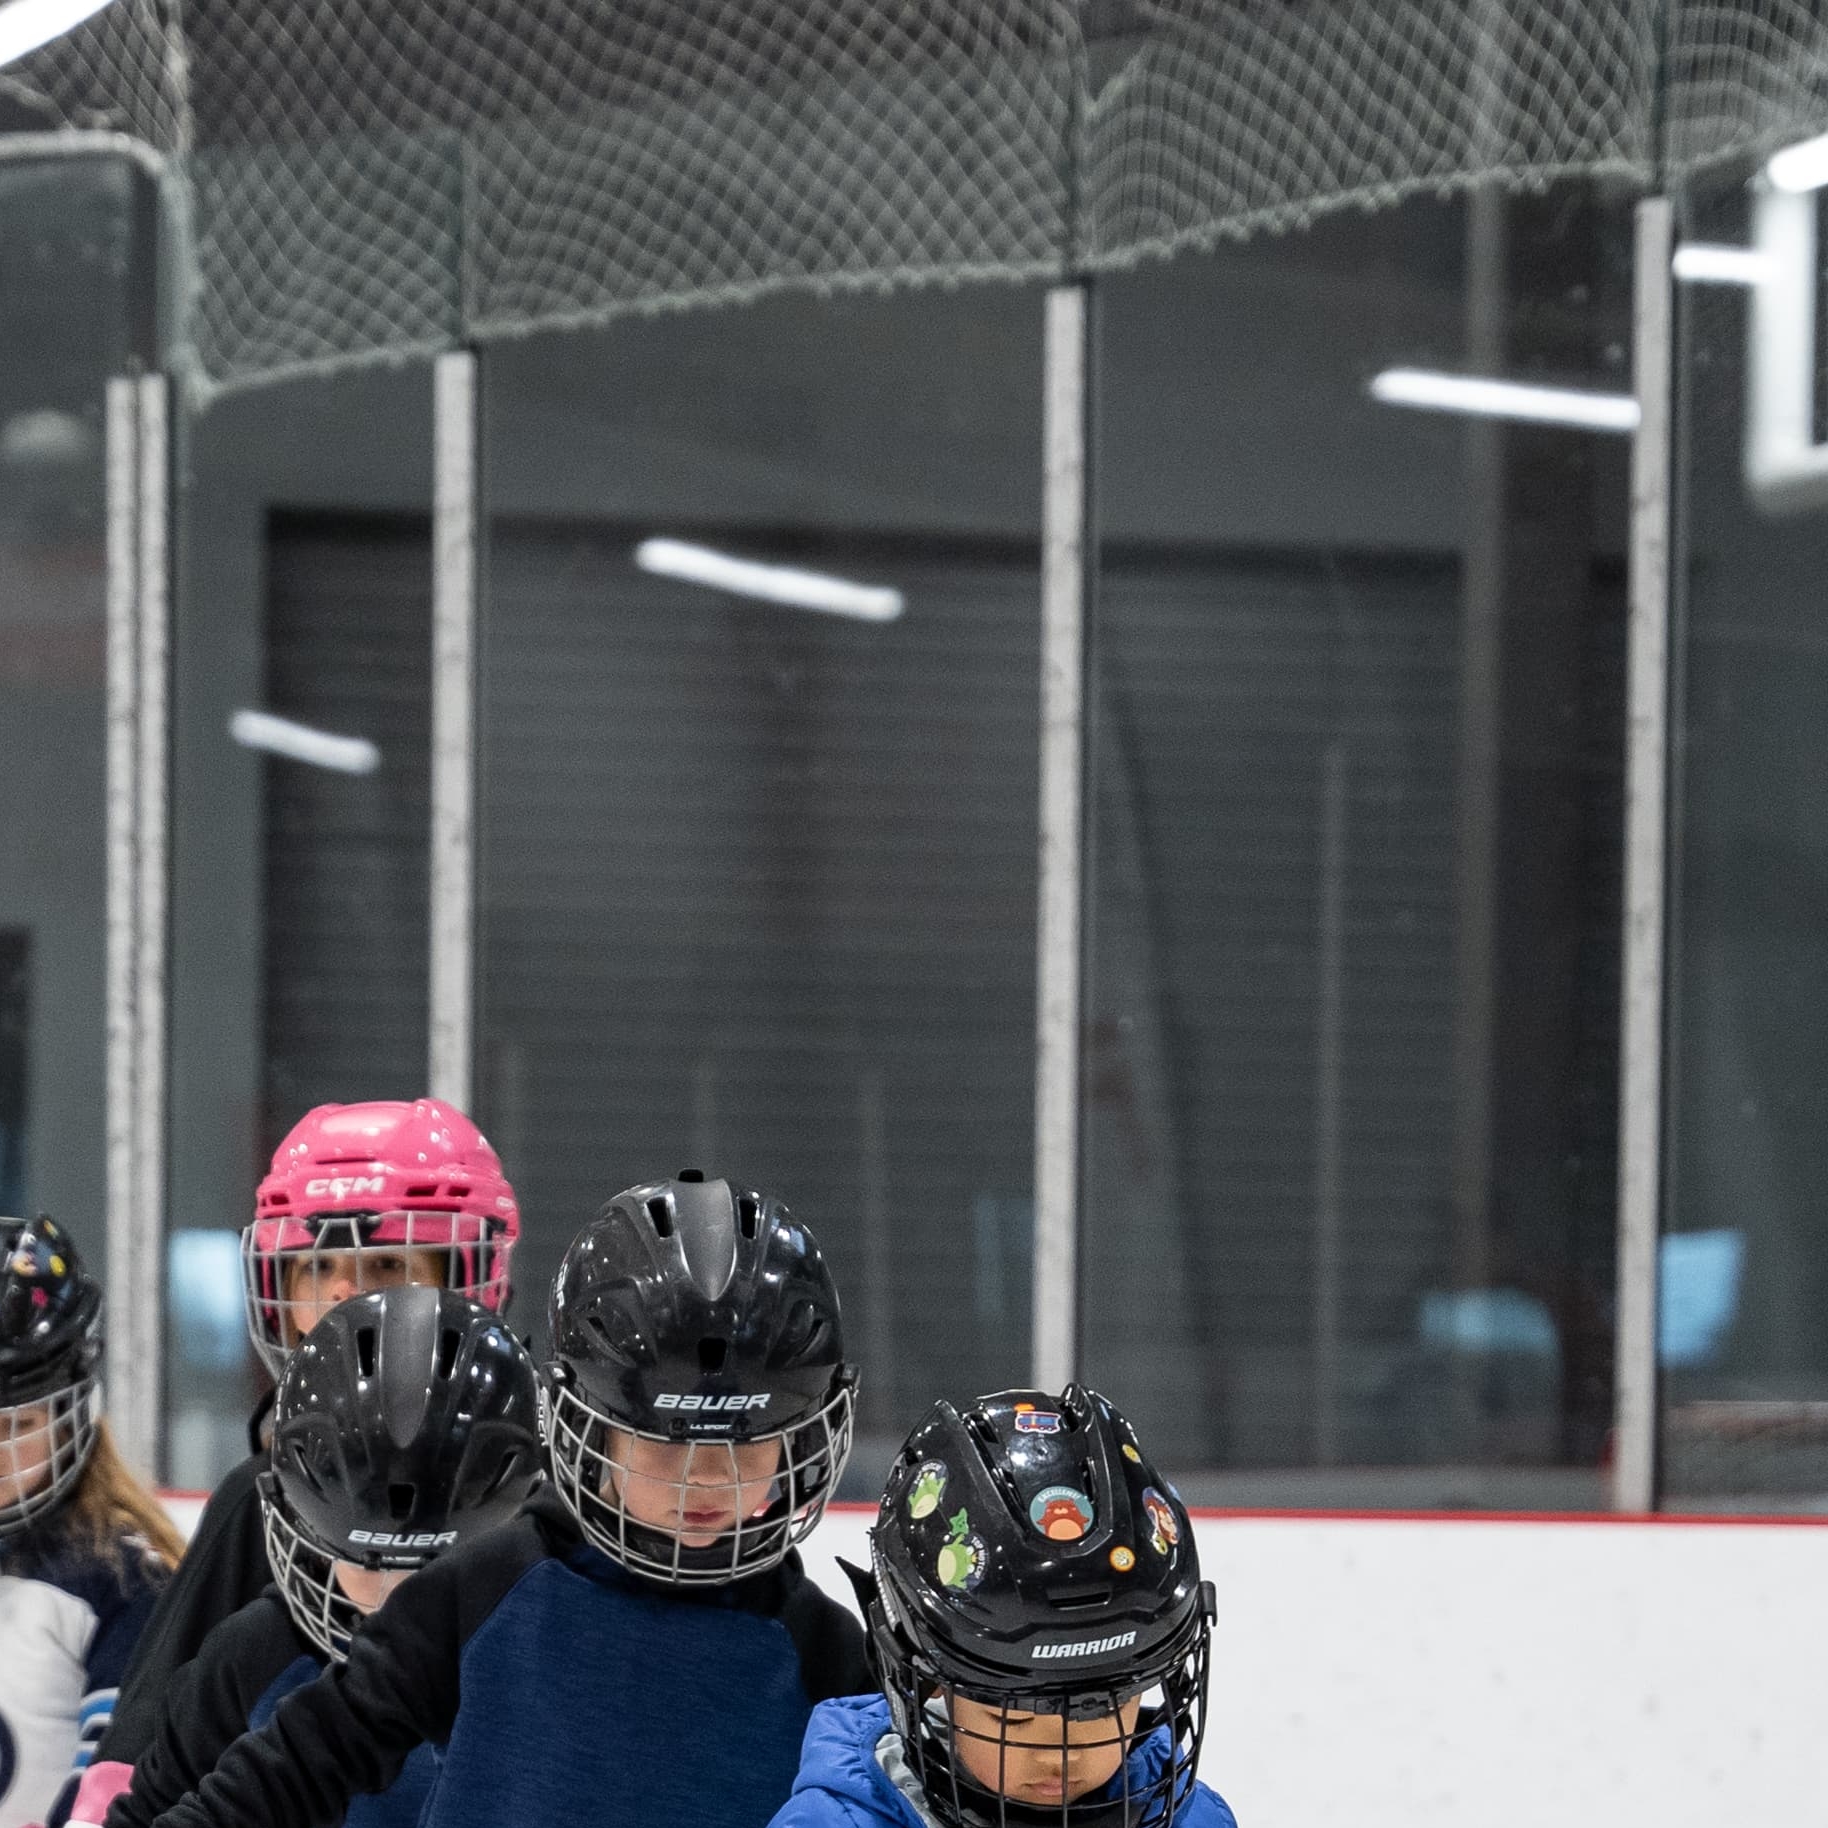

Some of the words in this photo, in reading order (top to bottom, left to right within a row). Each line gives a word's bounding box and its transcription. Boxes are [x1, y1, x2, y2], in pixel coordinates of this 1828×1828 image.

[305, 1177, 385, 1198] CCM
[653, 1393, 771, 1410] BAUER
[348, 1529, 458, 1546] BAUER
[1032, 1631, 1137, 1659] WARRIOR
